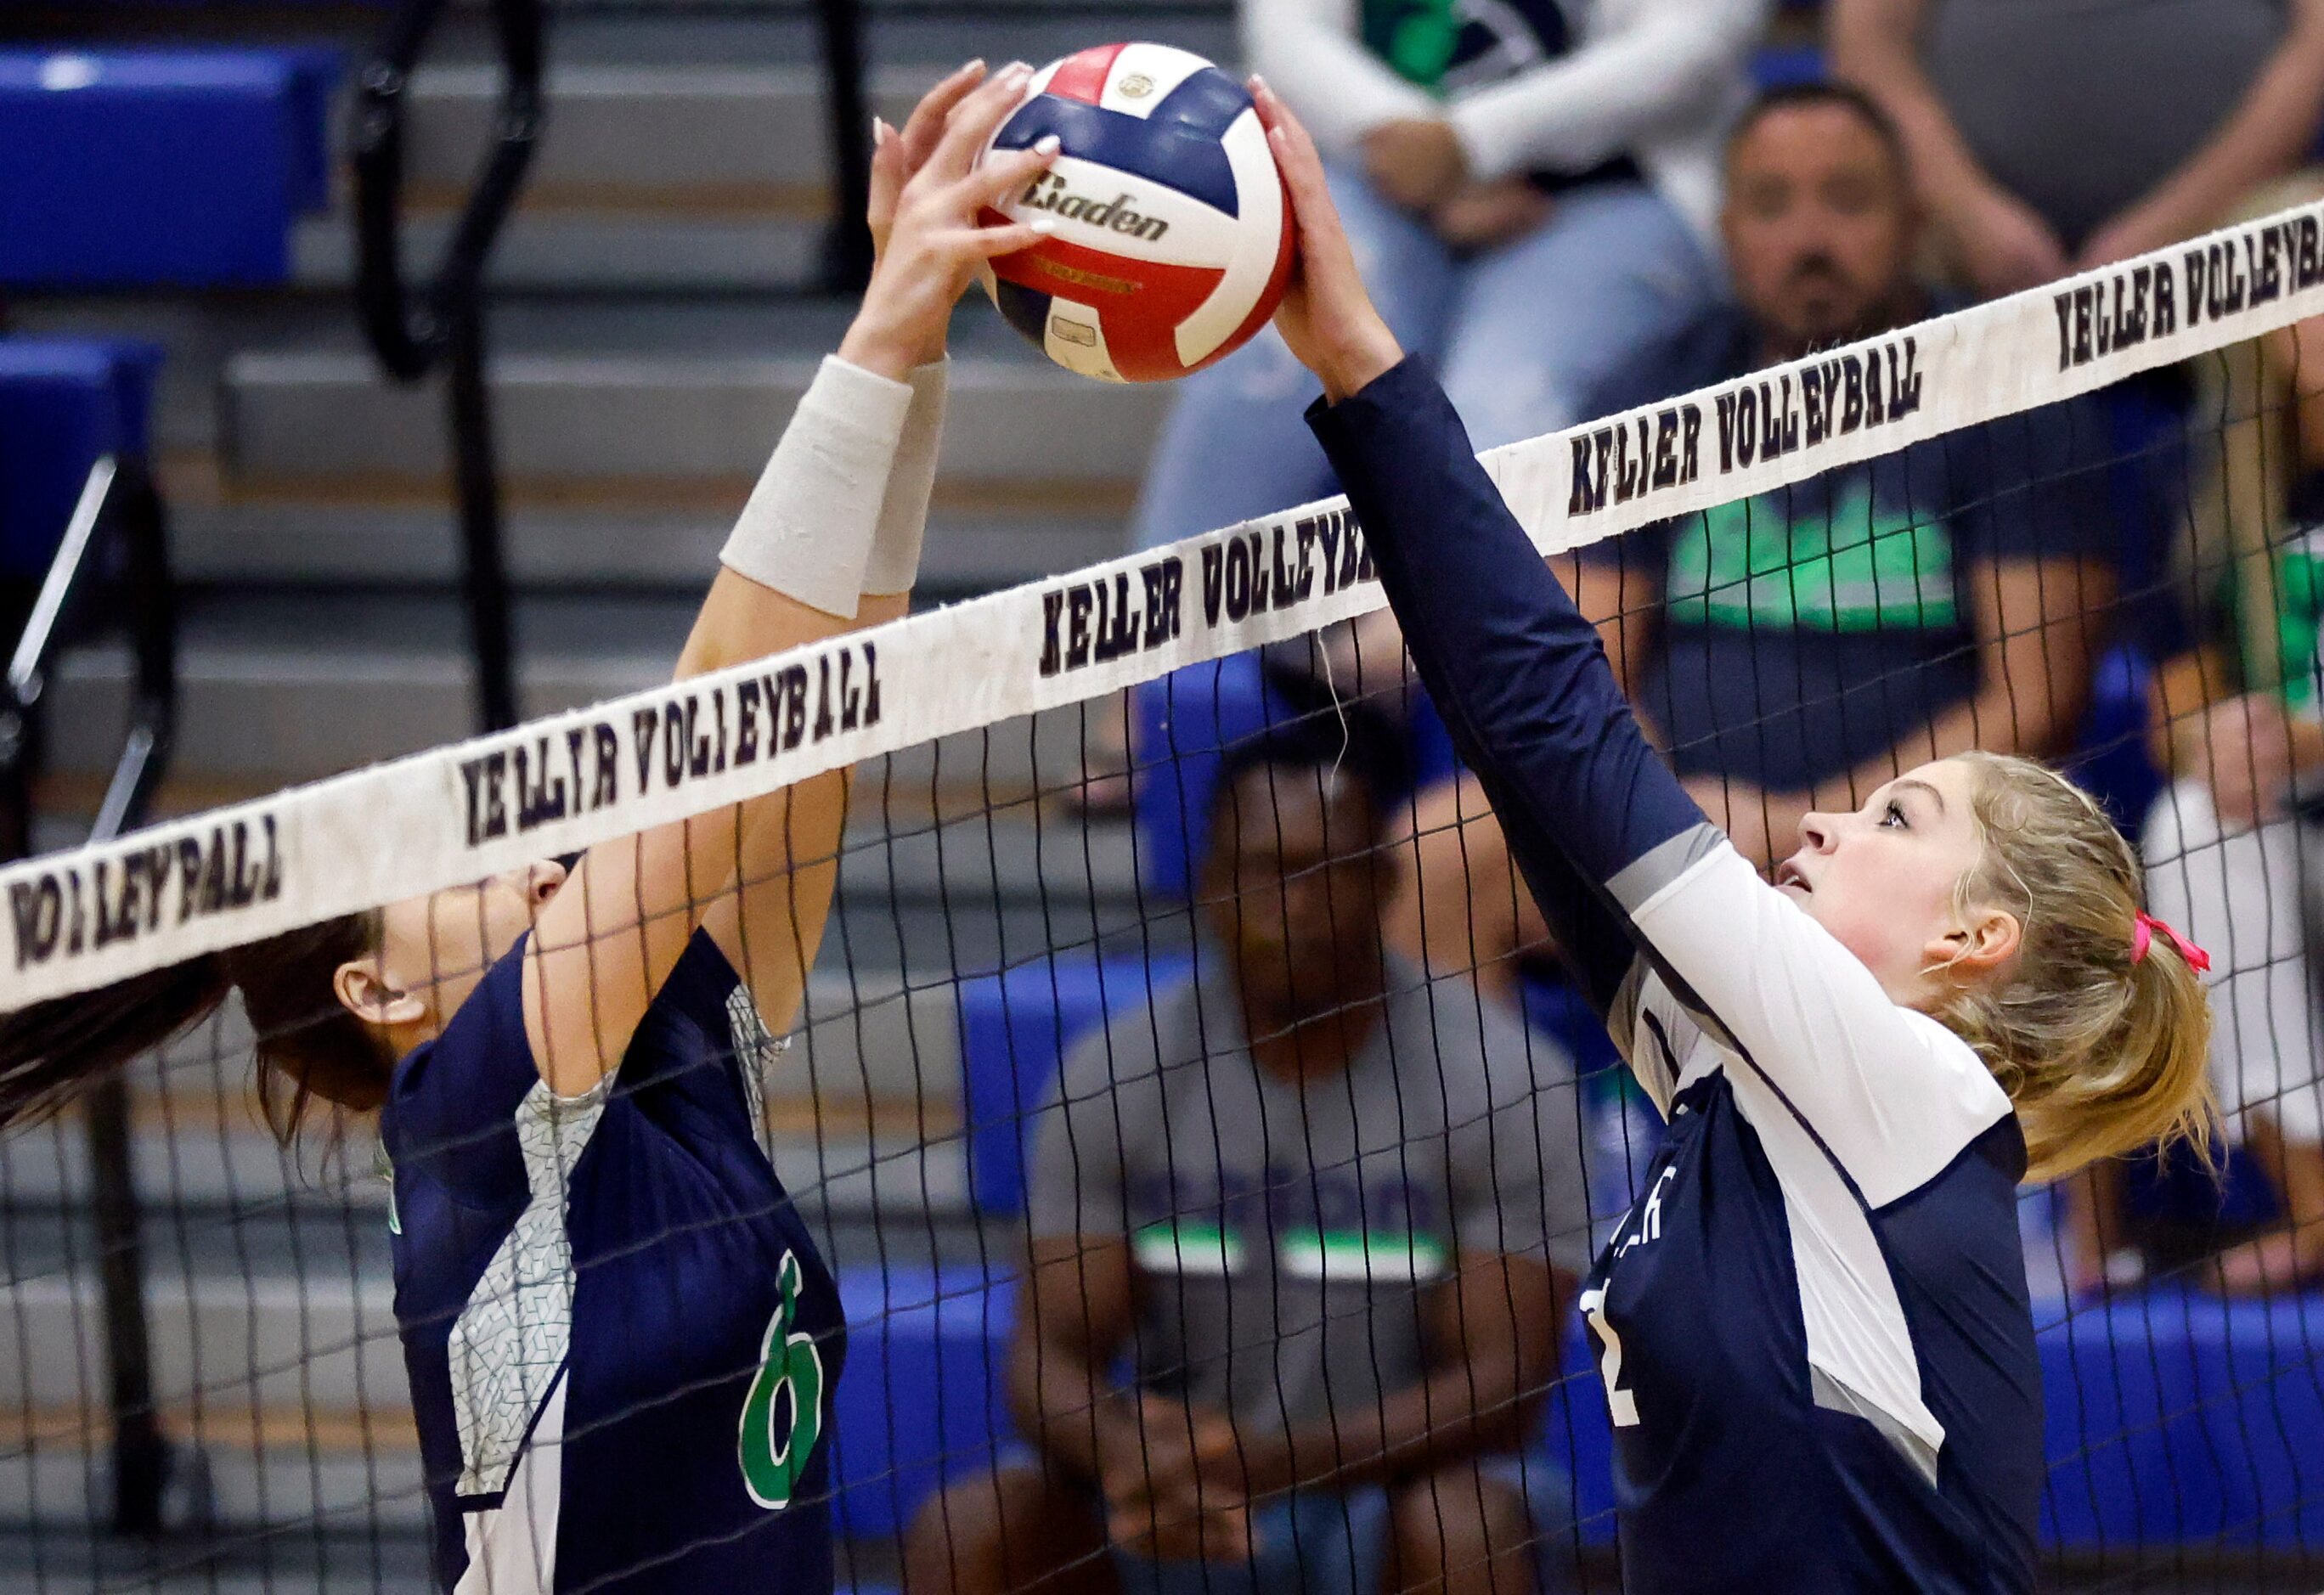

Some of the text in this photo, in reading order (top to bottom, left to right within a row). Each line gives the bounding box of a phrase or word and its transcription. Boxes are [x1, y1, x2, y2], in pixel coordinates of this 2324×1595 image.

[1714, 336, 1922, 474] VOLLEYBALL
[1039, 557, 1183, 678] KELLER
[738, 1248, 823, 1510] 6
